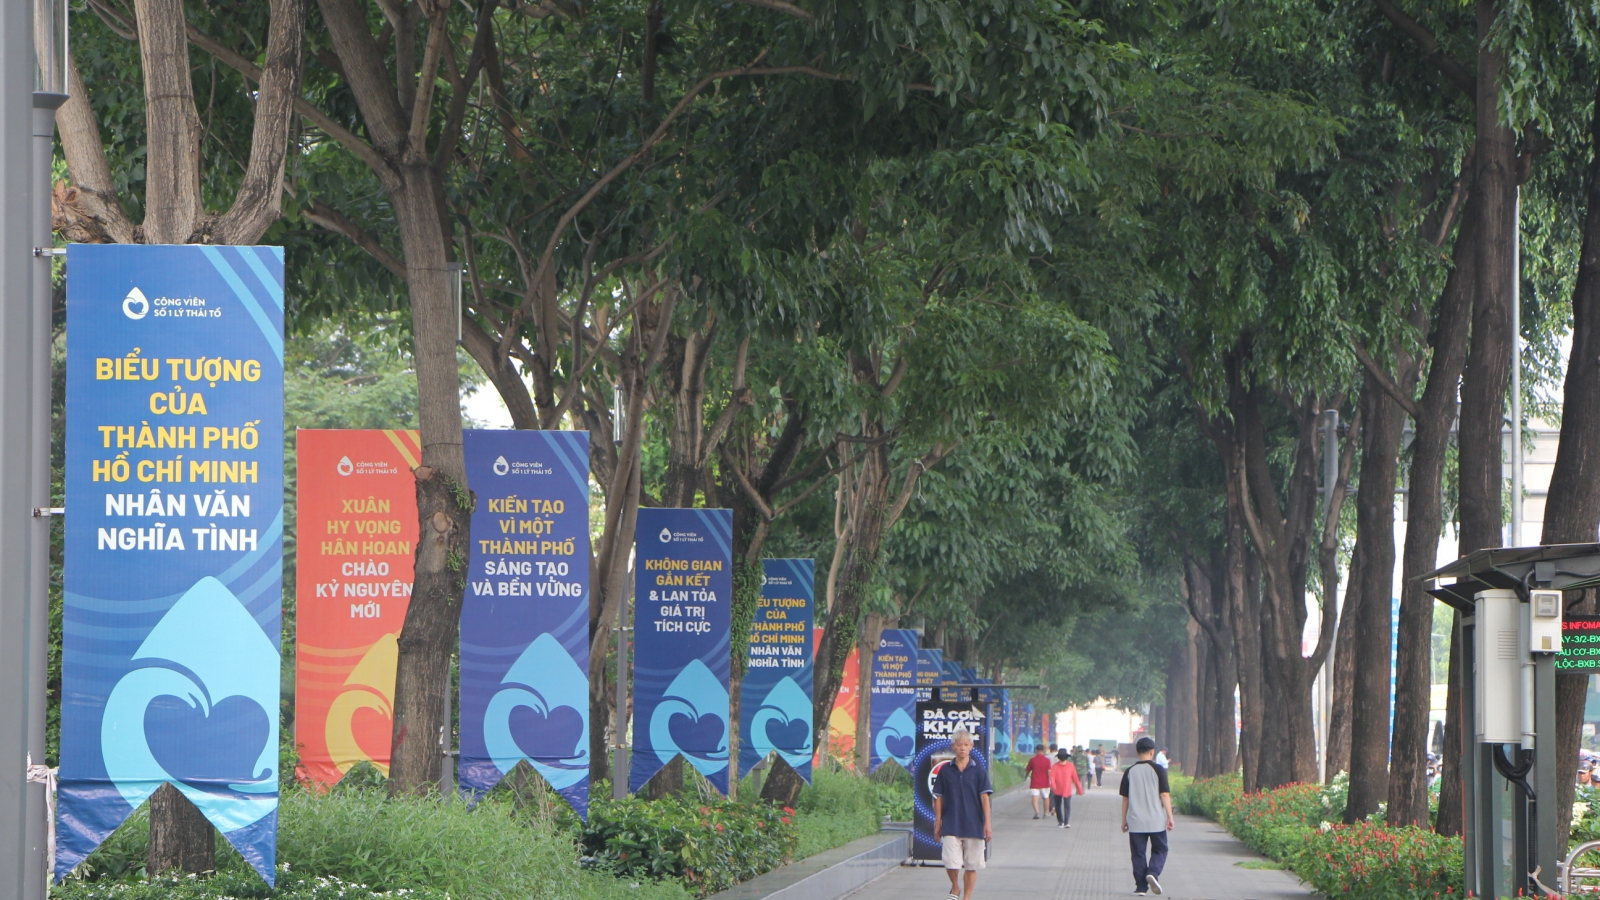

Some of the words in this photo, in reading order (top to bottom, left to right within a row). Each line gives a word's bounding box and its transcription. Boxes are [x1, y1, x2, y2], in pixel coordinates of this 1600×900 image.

[154, 296, 182, 306] CÔNG
[183, 296, 206, 307] VIÊN
[154, 306, 167, 317] SỐ
[168, 309, 172, 317] 1
[174, 306, 184, 317] LÝ
[184, 307, 208, 318] THÁI
[208, 306, 222, 318] TỔ
[96, 347, 159, 380] BIỂU
[166, 356, 261, 388] TƯỢNG
[150, 386, 208, 414] CỦA
[98, 421, 196, 448] THÀNH
[203, 420, 261, 450] PHỐ
[92, 451, 130, 482] HỒ
[137, 455, 182, 482] CHÍ
[190, 460, 258, 483] MINH
[105, 489, 186, 516] NHÂN
[193, 490, 250, 518] VĂN
[342, 496, 390, 514] XUÂN
[488, 494, 528, 513] KIẾN
[531, 499, 564, 518] TẠO
[327, 520, 350, 534] HY
[354, 520, 401, 538] VỌNG
[499, 516, 516, 534] VÌ
[520, 517, 554, 538] MỘT
[98, 523, 185, 550] NGHĨA
[192, 524, 257, 551] TÌNH
[479, 537, 538, 554] THÀNH
[541, 536, 575, 555] PHỐ
[321, 538, 358, 555] HÂN
[362, 541, 410, 555] HOAN
[342, 558, 389, 576] CHÀO
[485, 558, 532, 576] SÁNG
[535, 562, 569, 580] TẠO
[645, 557, 689, 570] KHÔNG
[691, 560, 722, 571] GIAN
[472, 578, 494, 596] VÀ
[498, 577, 532, 596] BỀN
[536, 579, 582, 597] VỮNG
[656, 571, 683, 585] GẮN
[686, 572, 711, 586] KẾT
[316, 578, 340, 598] KỶ
[344, 580, 414, 597] NGUYÊN
[649, 590, 658, 601] &
[662, 591, 688, 601] LAN
[691, 588, 717, 602] TỎA
[350, 601, 380, 618] MỚI
[660, 604, 682, 616] GIÁ
[685, 606, 705, 620] TRỊ
[772, 598, 806, 609] TƯỢNG
[766, 608, 787, 619] CỦA
[654, 619, 683, 632] TÍCH
[686, 621, 711, 635] CỰC
[784, 620, 805, 631] PHỐ
[762, 633, 778, 643] CHÍ
[780, 635, 805, 643] MINH
[751, 645, 779, 655] NHÂN
[781, 645, 802, 655] VĂN
[748, 657, 779, 667] NGHĨA
[781, 657, 804, 667] TÌNH
[923, 708, 945, 719] ĐÃ
